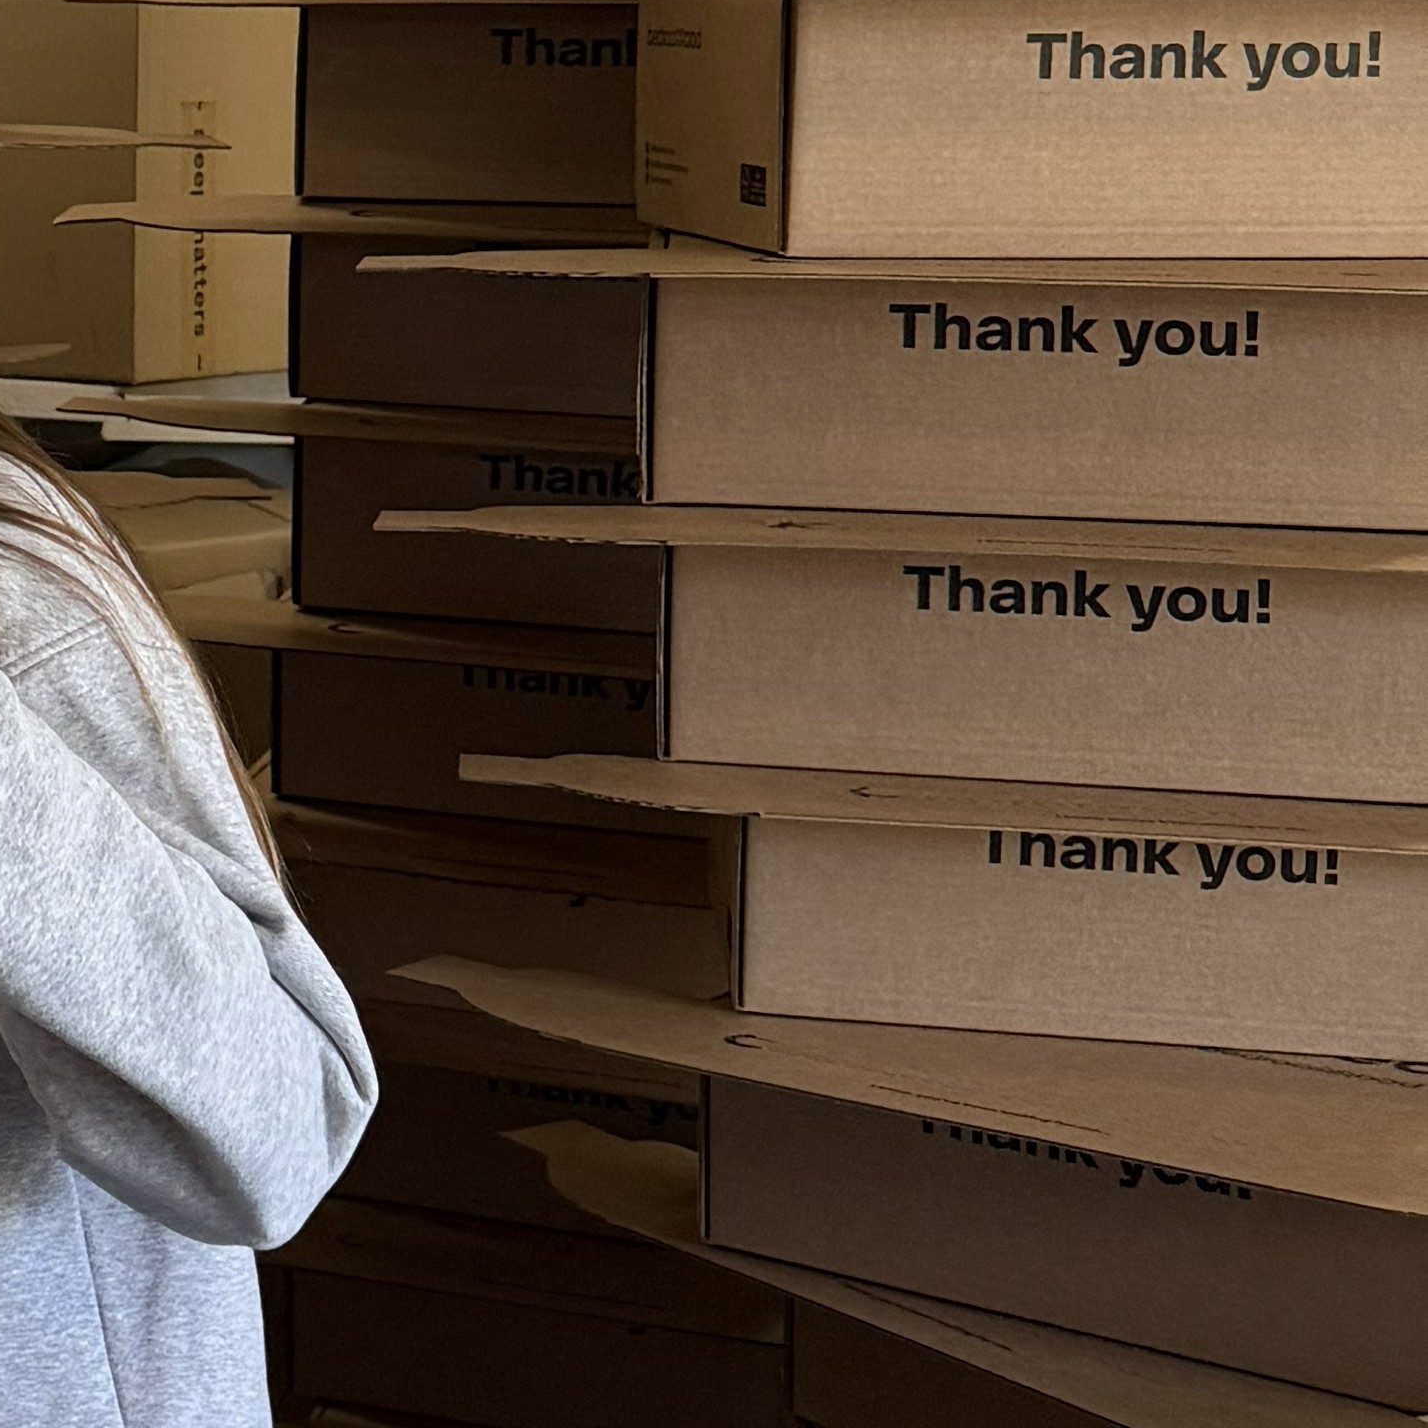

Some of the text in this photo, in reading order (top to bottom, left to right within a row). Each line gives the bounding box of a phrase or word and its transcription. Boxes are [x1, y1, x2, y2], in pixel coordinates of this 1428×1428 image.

[1026, 29, 1382, 92] Thank you!
[889, 303, 1260, 368] Thank you!
[480, 452, 641, 499] Thank
[903, 564, 1273, 632] Thank you!
[1194, 841, 1340, 892] you!
